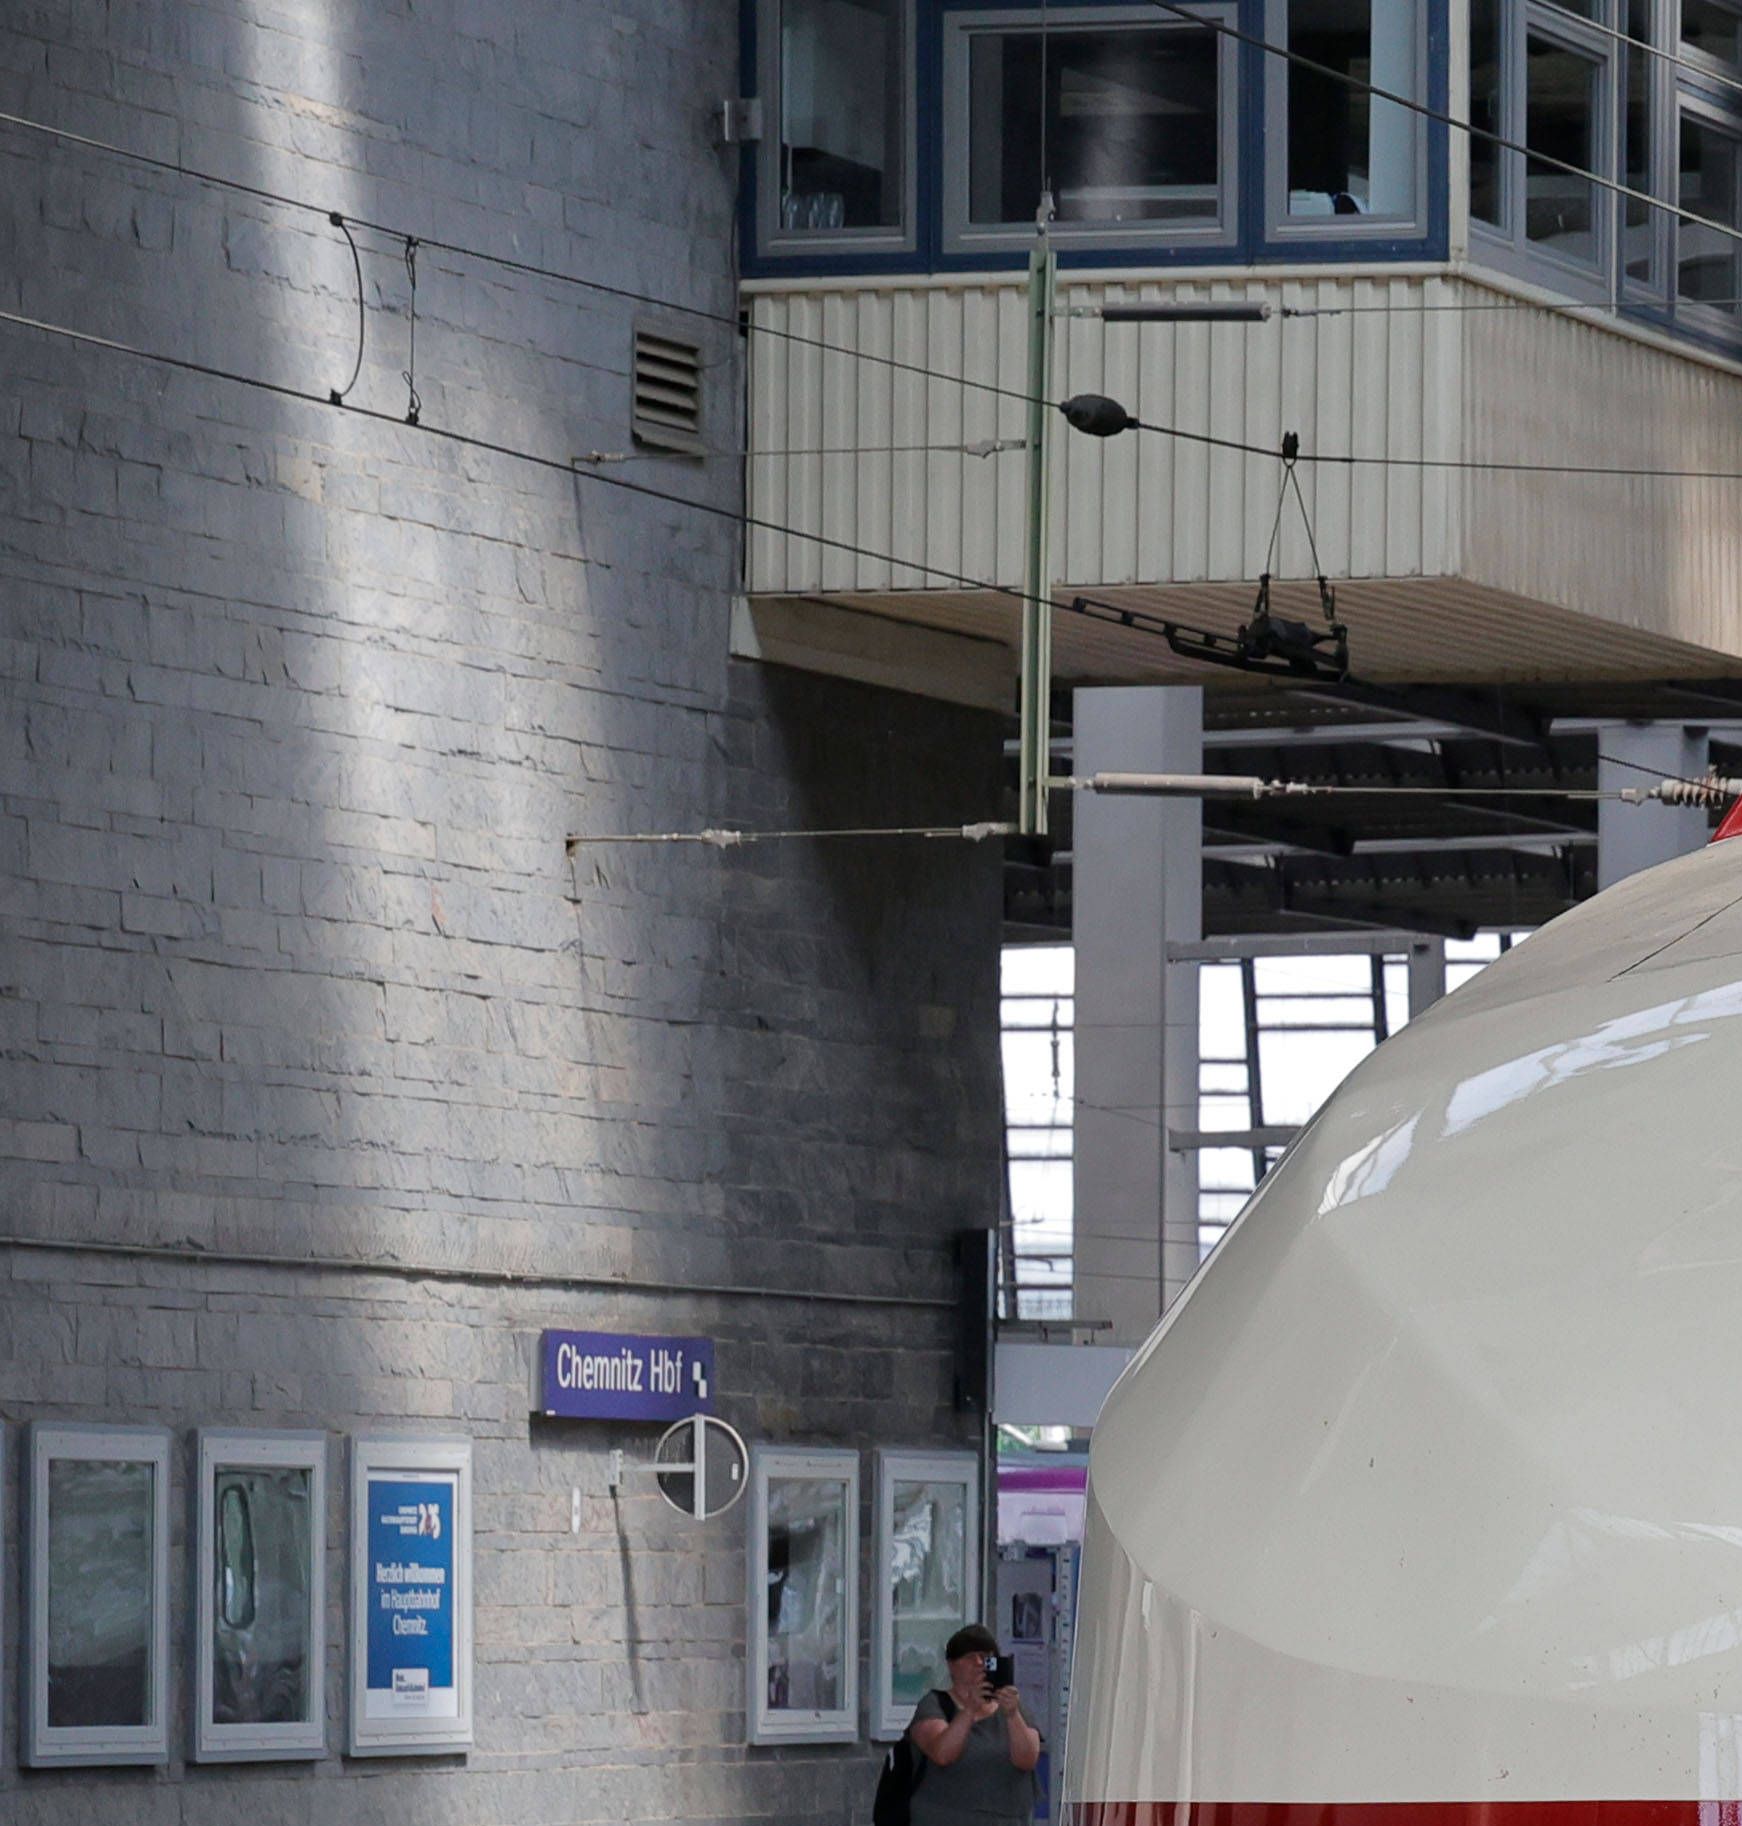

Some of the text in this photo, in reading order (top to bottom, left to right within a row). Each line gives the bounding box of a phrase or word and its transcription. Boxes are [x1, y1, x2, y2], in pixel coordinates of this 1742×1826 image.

[557, 1342, 683, 1394] Chemnitz Hbf
[376, 1561, 446, 1585] Herzlich willkommen
[391, 1587, 441, 1614] Hauptbahnhof
